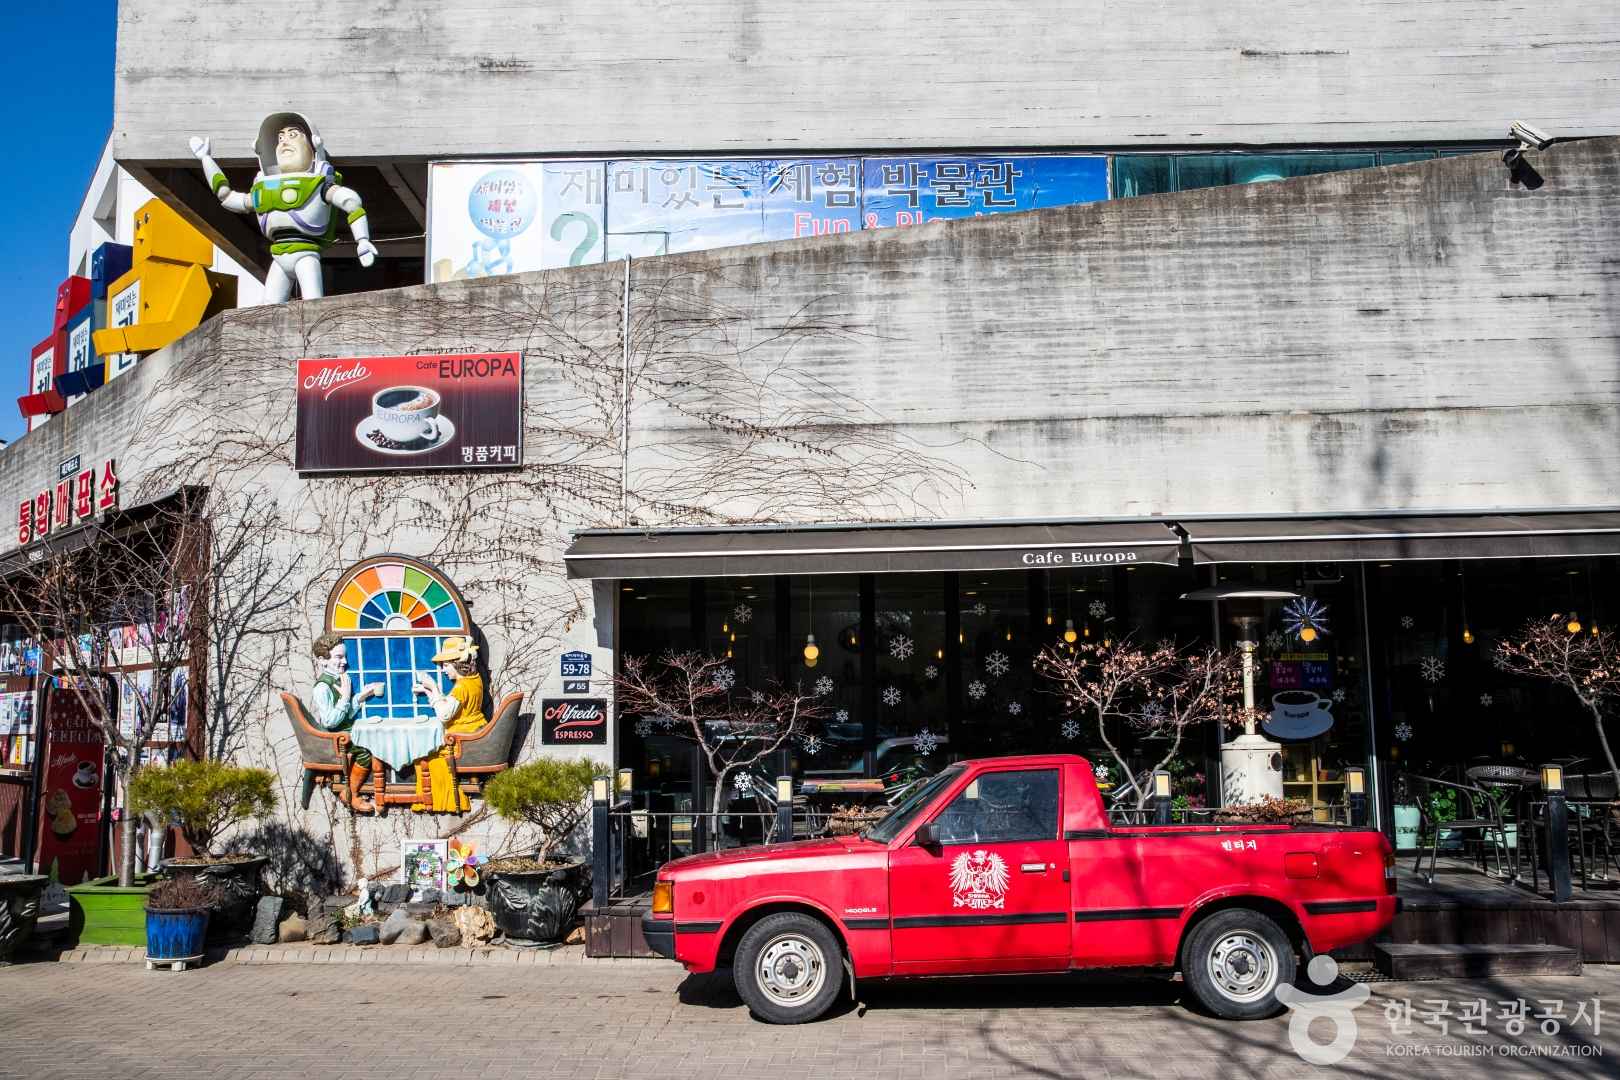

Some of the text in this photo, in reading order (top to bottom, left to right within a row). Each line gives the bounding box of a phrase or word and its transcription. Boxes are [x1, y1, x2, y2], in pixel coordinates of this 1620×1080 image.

[559, 162, 1022, 210] 재미있는 체험 박물관
[792, 211, 850, 239] Fun
[303, 361, 371, 395] Alfredo
[438, 358, 516, 379] EUROPA
[461, 445, 517, 463] 명품커피
[18, 459, 117, 545] 통합매표소
[1022, 551, 1137, 564] Cafe Europa
[562, 663, 590, 674] 59-78
[544, 702, 605, 726] Alfredo
[555, 730, 594, 740] ESPRESSO
[1221, 839, 1257, 851] 빈티지
